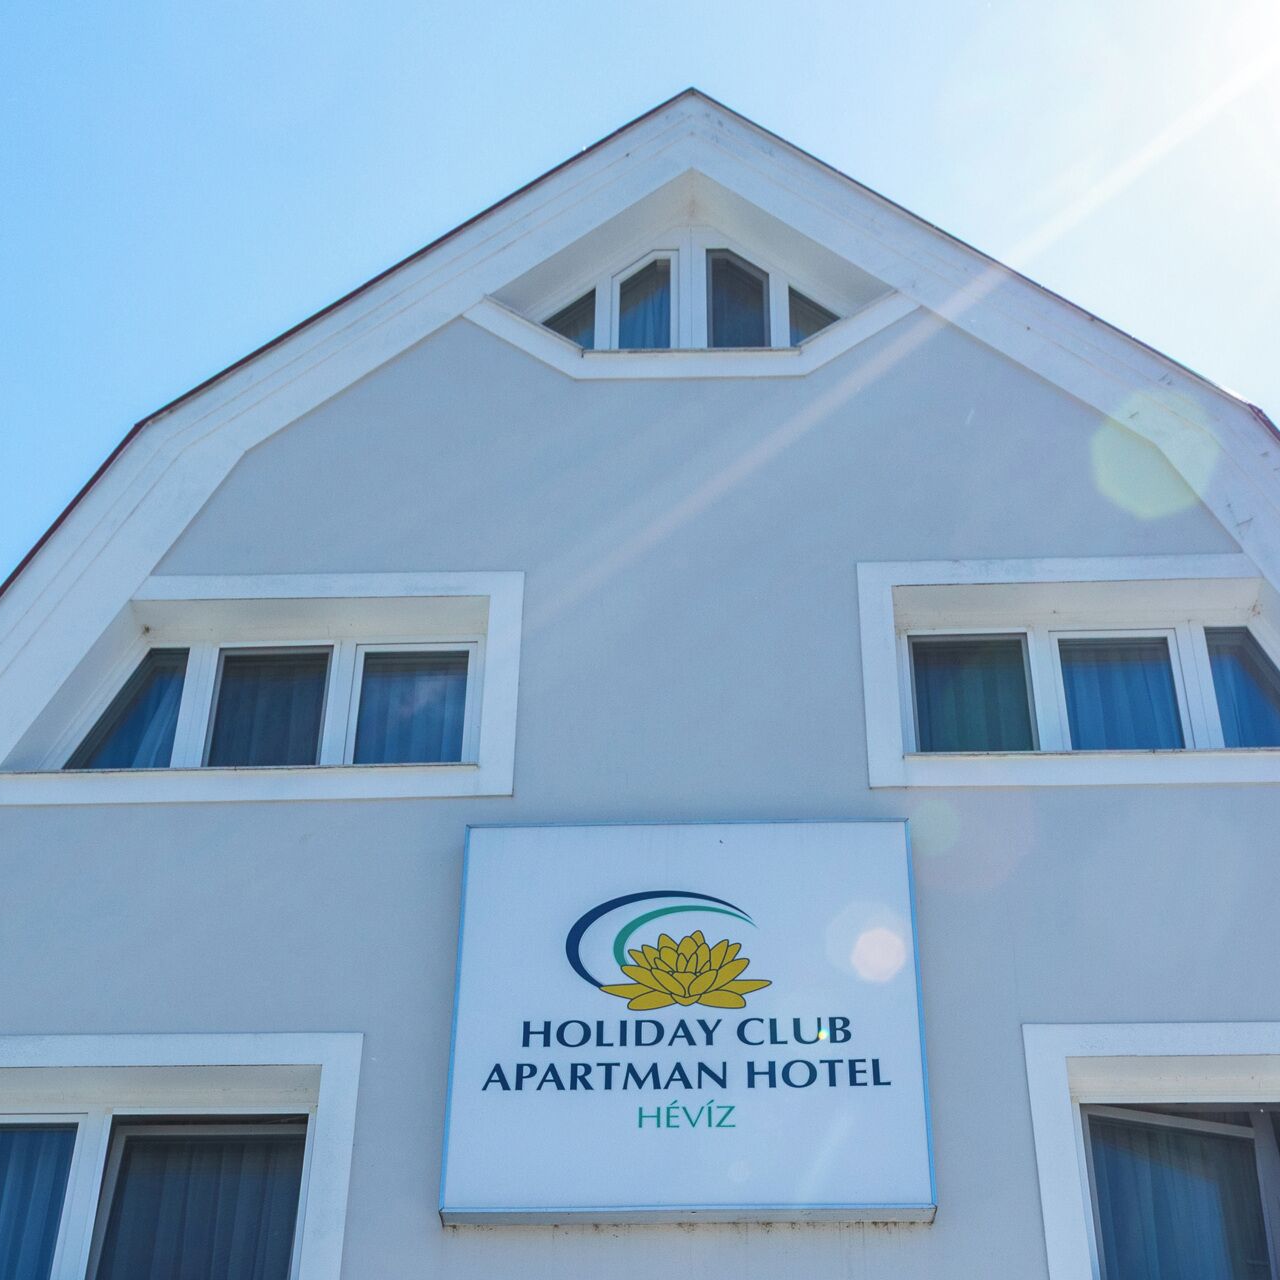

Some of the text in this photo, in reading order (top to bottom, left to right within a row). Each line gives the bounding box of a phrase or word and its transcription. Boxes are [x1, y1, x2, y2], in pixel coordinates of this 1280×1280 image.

[523, 1017, 851, 1047] HOLIDAY CLUB
[482, 1059, 891, 1090] APARTMAN HOTEL
[639, 1100, 735, 1128] HÉVÍZ
